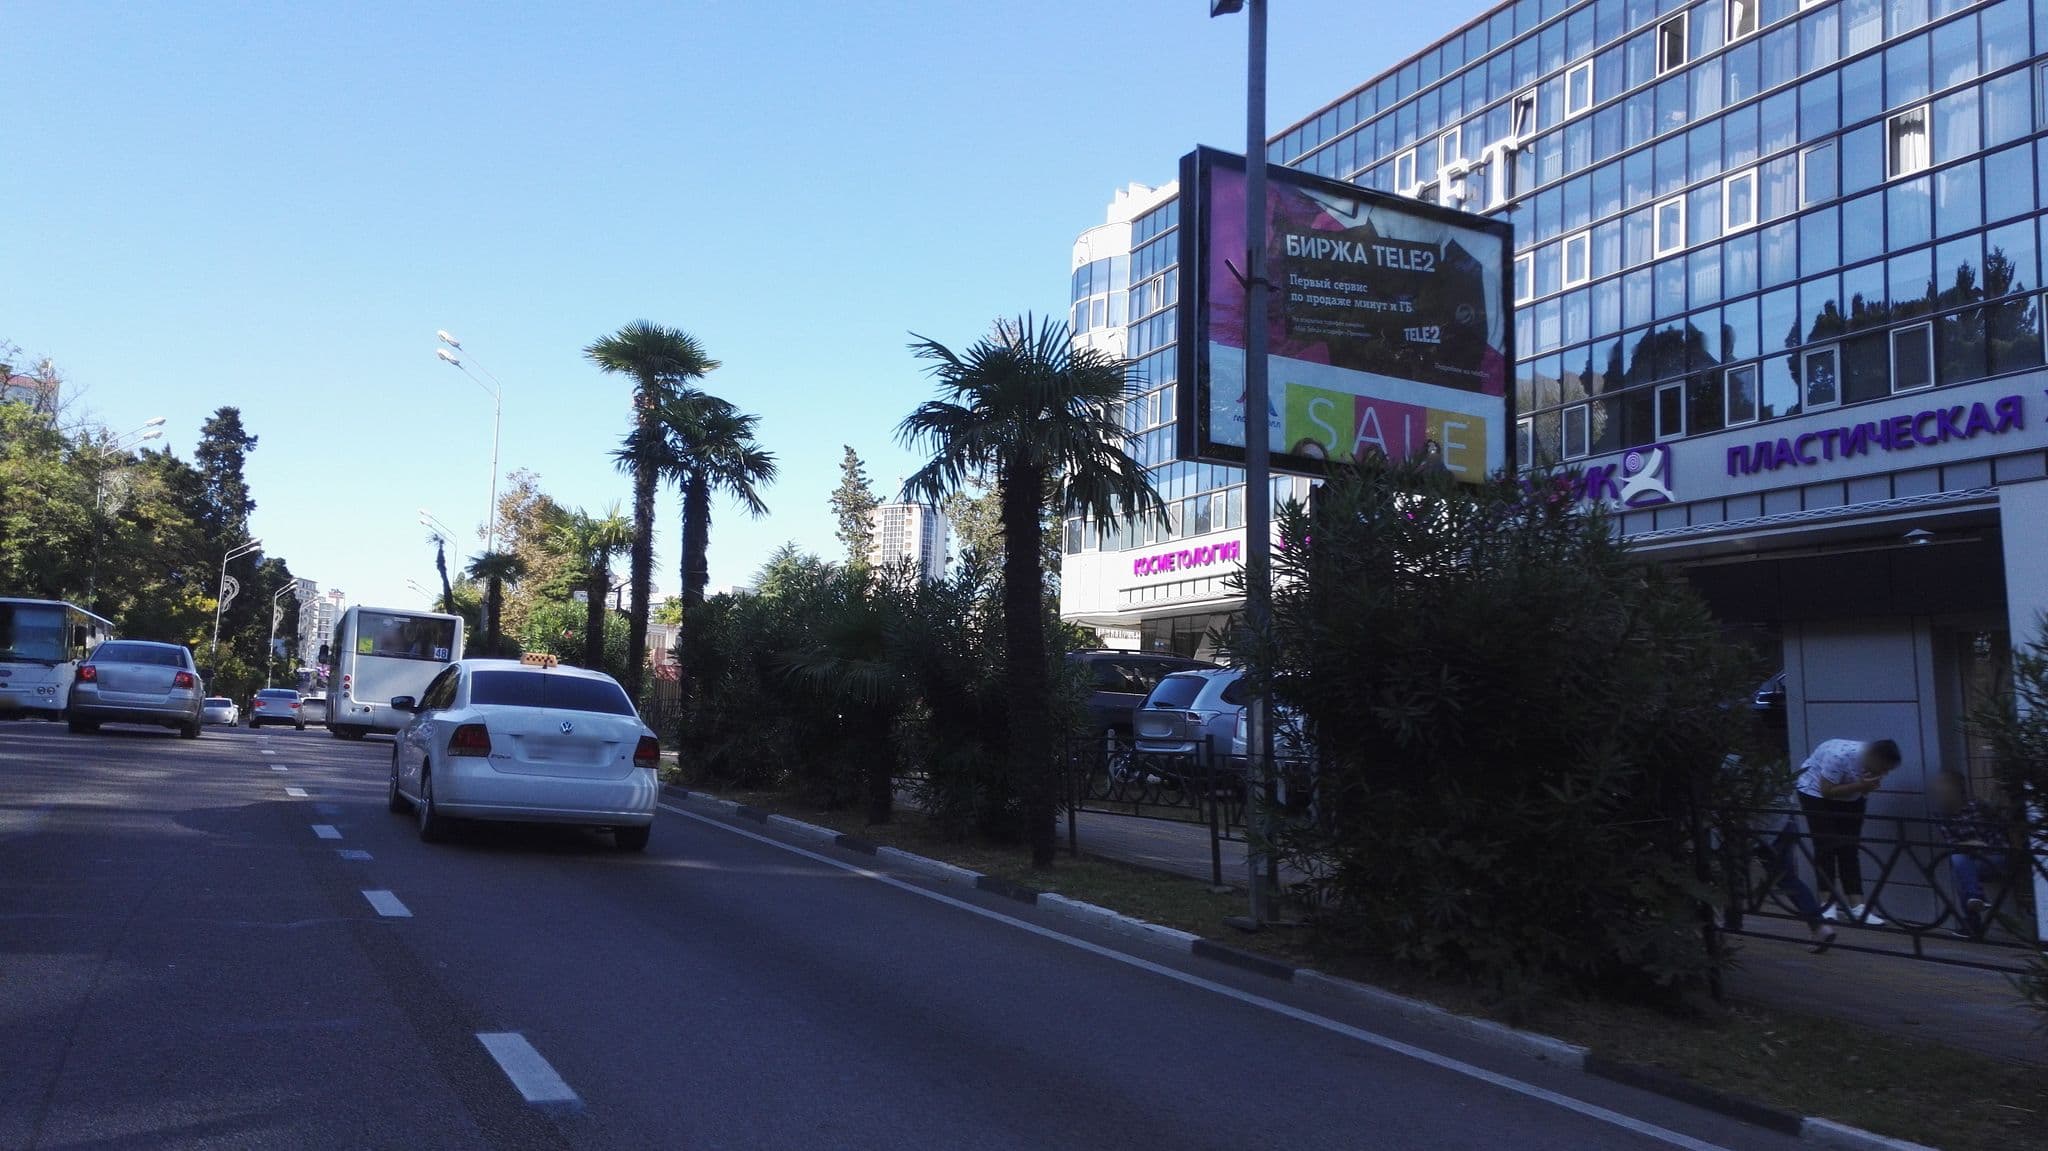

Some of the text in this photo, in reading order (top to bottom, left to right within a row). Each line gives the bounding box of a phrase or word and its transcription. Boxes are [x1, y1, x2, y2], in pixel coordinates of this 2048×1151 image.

[1286, 234, 1435, 273] БИРЖА TELE2
[1290, 274, 1368, 293] Первый сервис
[1291, 293, 1304, 302] по
[1306, 294, 1351, 307] продаже
[1354, 299, 1387, 313] минут
[1390, 303, 1397, 312] и
[1404, 325, 1441, 344] TELE2
[1727, 395, 2025, 477] ПЛАСТИЧЕСКАЯ
[1134, 541, 1241, 576] КОСМЕТОЛОГИЯ
[435, 649, 447, 658] 48
